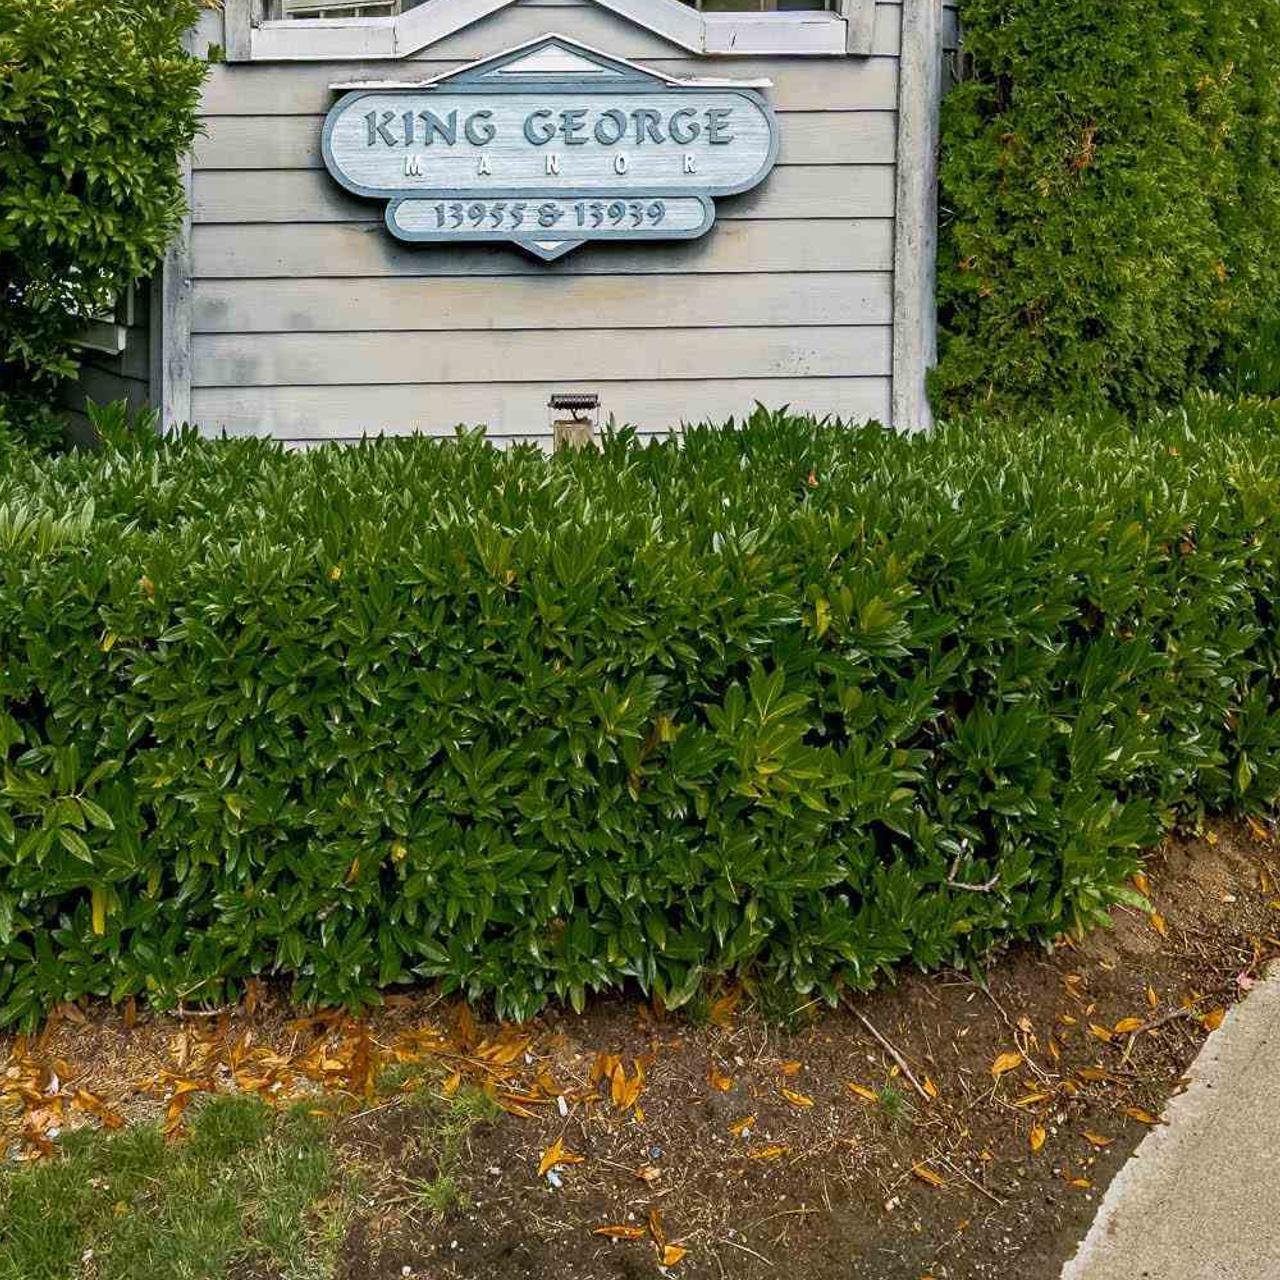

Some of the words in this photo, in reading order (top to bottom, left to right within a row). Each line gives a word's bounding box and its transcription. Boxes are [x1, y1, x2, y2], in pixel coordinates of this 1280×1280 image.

[365, 109, 497, 147] KING
[524, 108, 734, 146] GEORGE
[404, 153, 696, 176] MANOR
[433, 202, 527, 228] 13955
[538, 203, 564, 227] &
[575, 201, 666, 227] 13939
